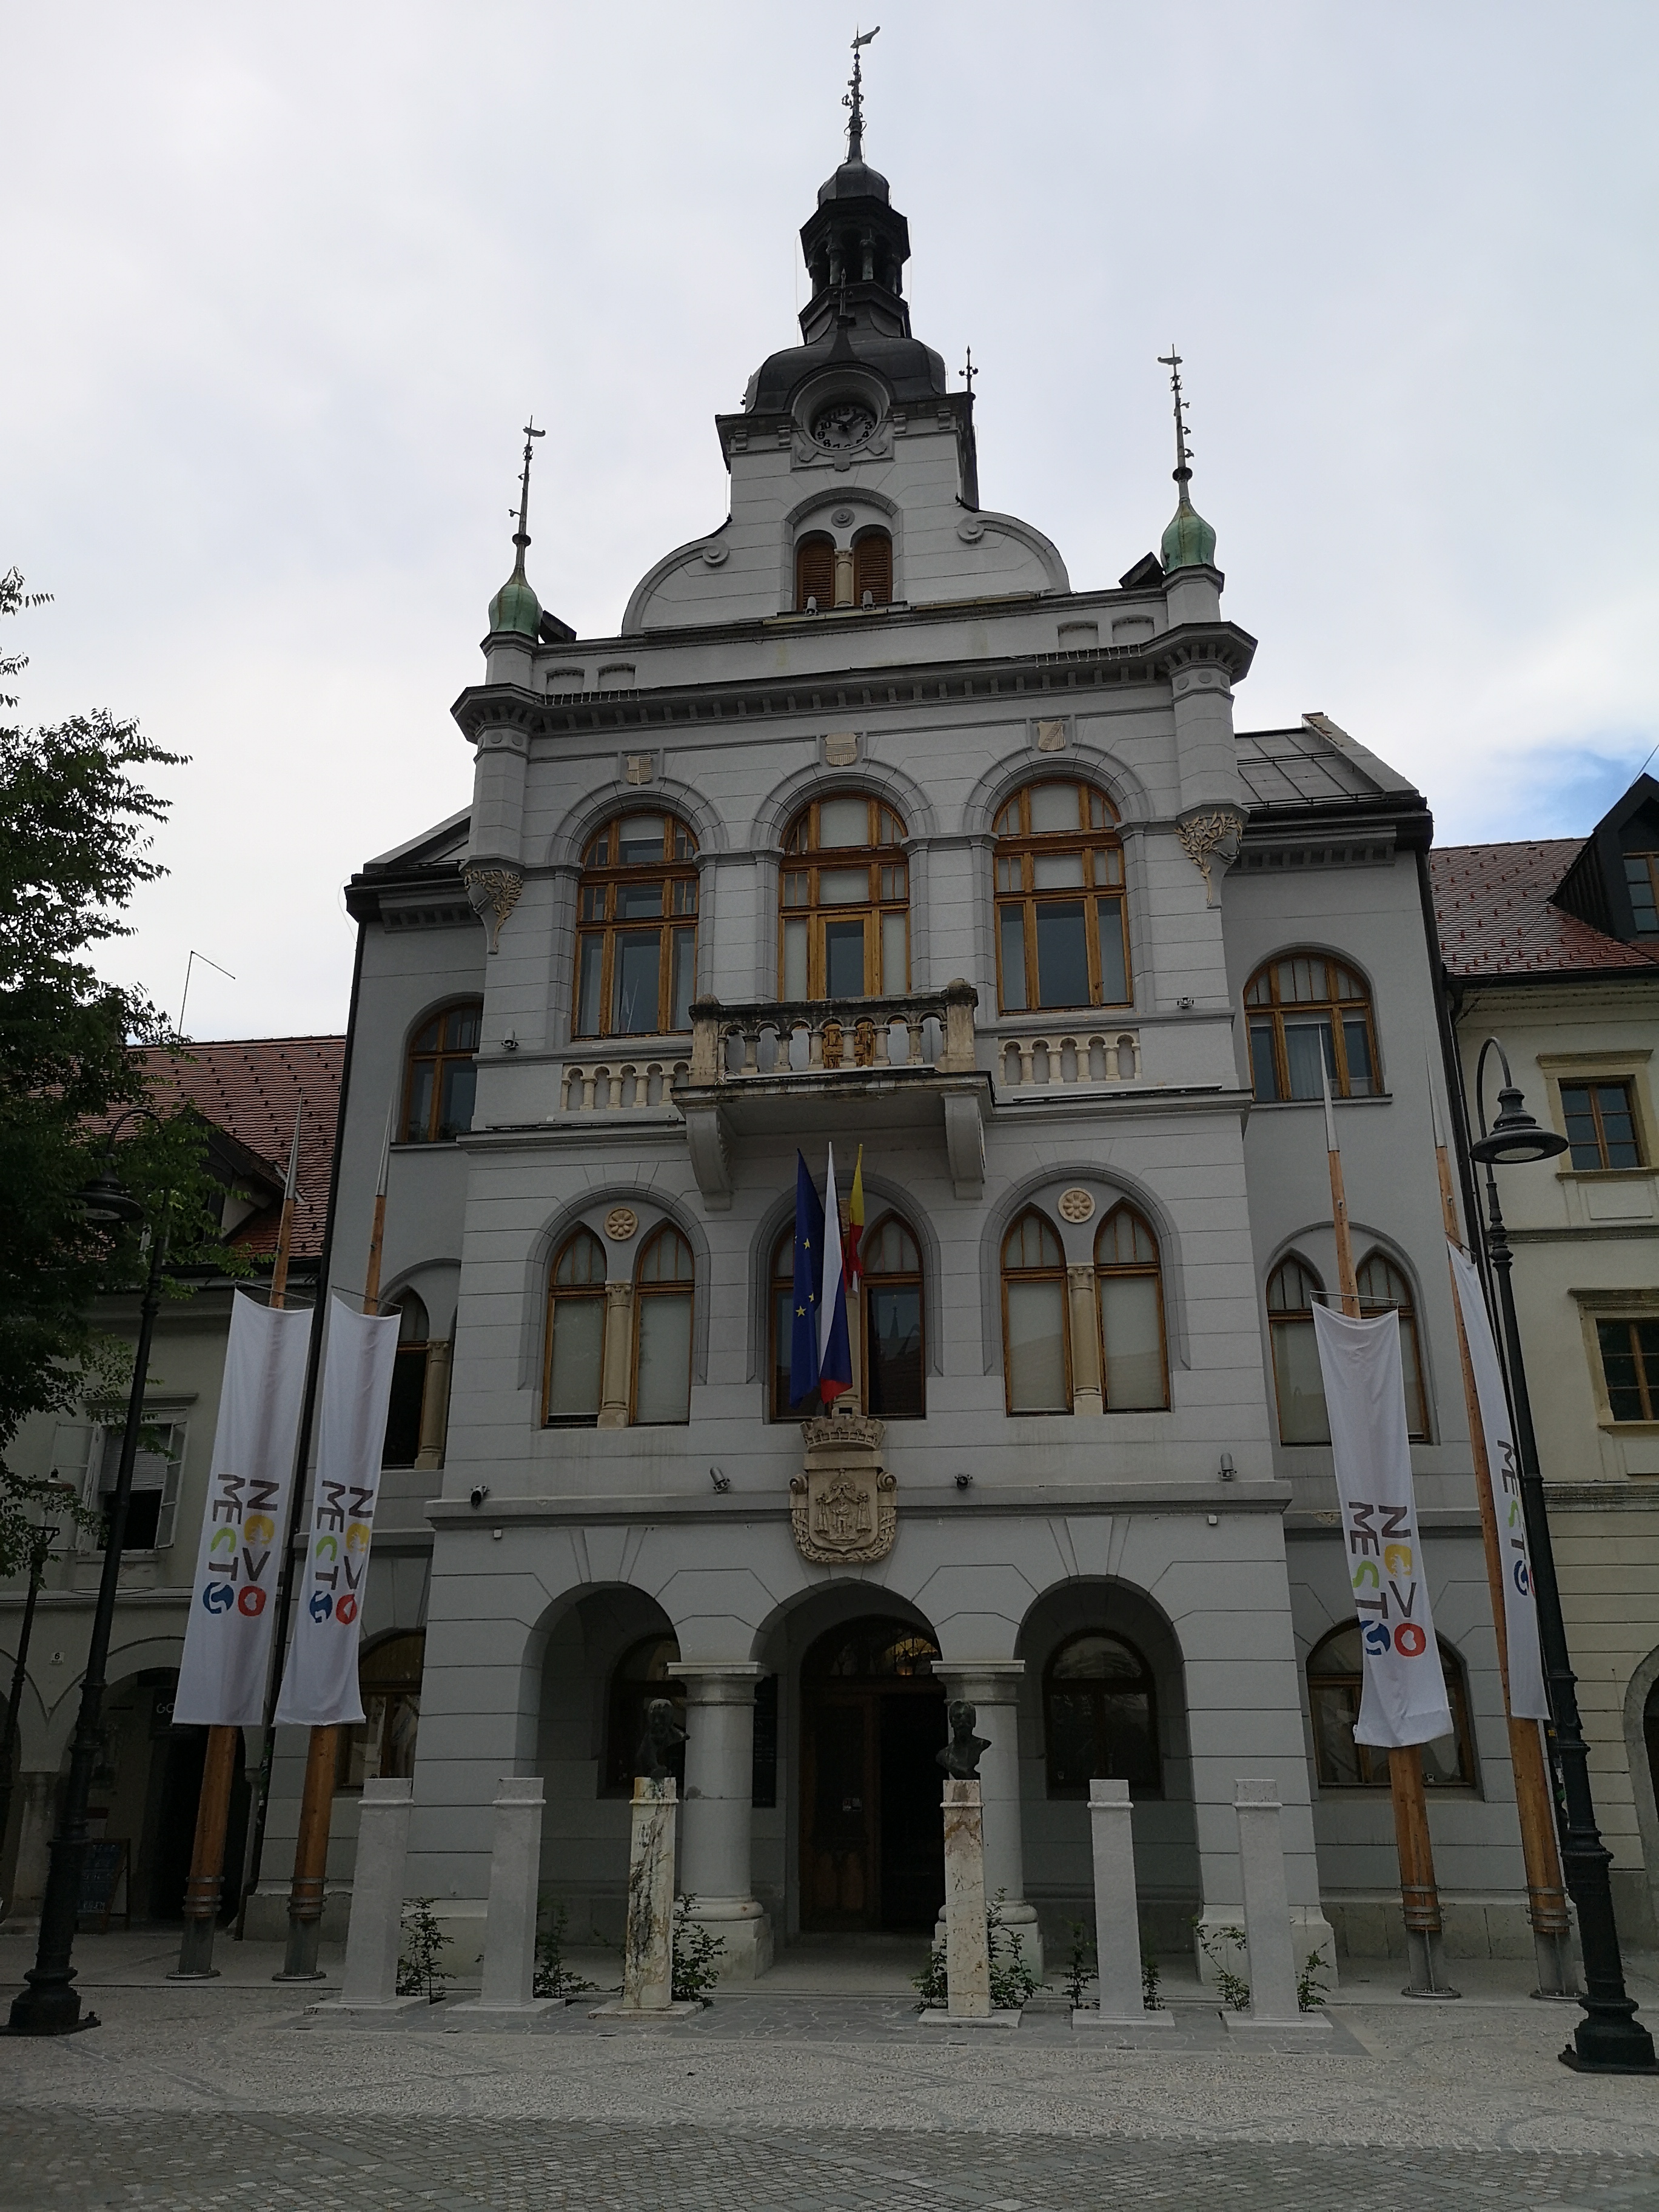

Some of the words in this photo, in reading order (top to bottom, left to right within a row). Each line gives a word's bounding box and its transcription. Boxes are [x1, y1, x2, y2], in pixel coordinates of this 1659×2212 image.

[820, 421, 831, 430] 10
[823, 439, 831, 447] 8
[865, 421, 873, 429] 3
[238, 1479, 280, 1617] NOVO
[335, 1486, 374, 1625] NOVO
[1348, 1501, 1391, 1655] MESTO
[1378, 1505, 1427, 1657] NOVO
